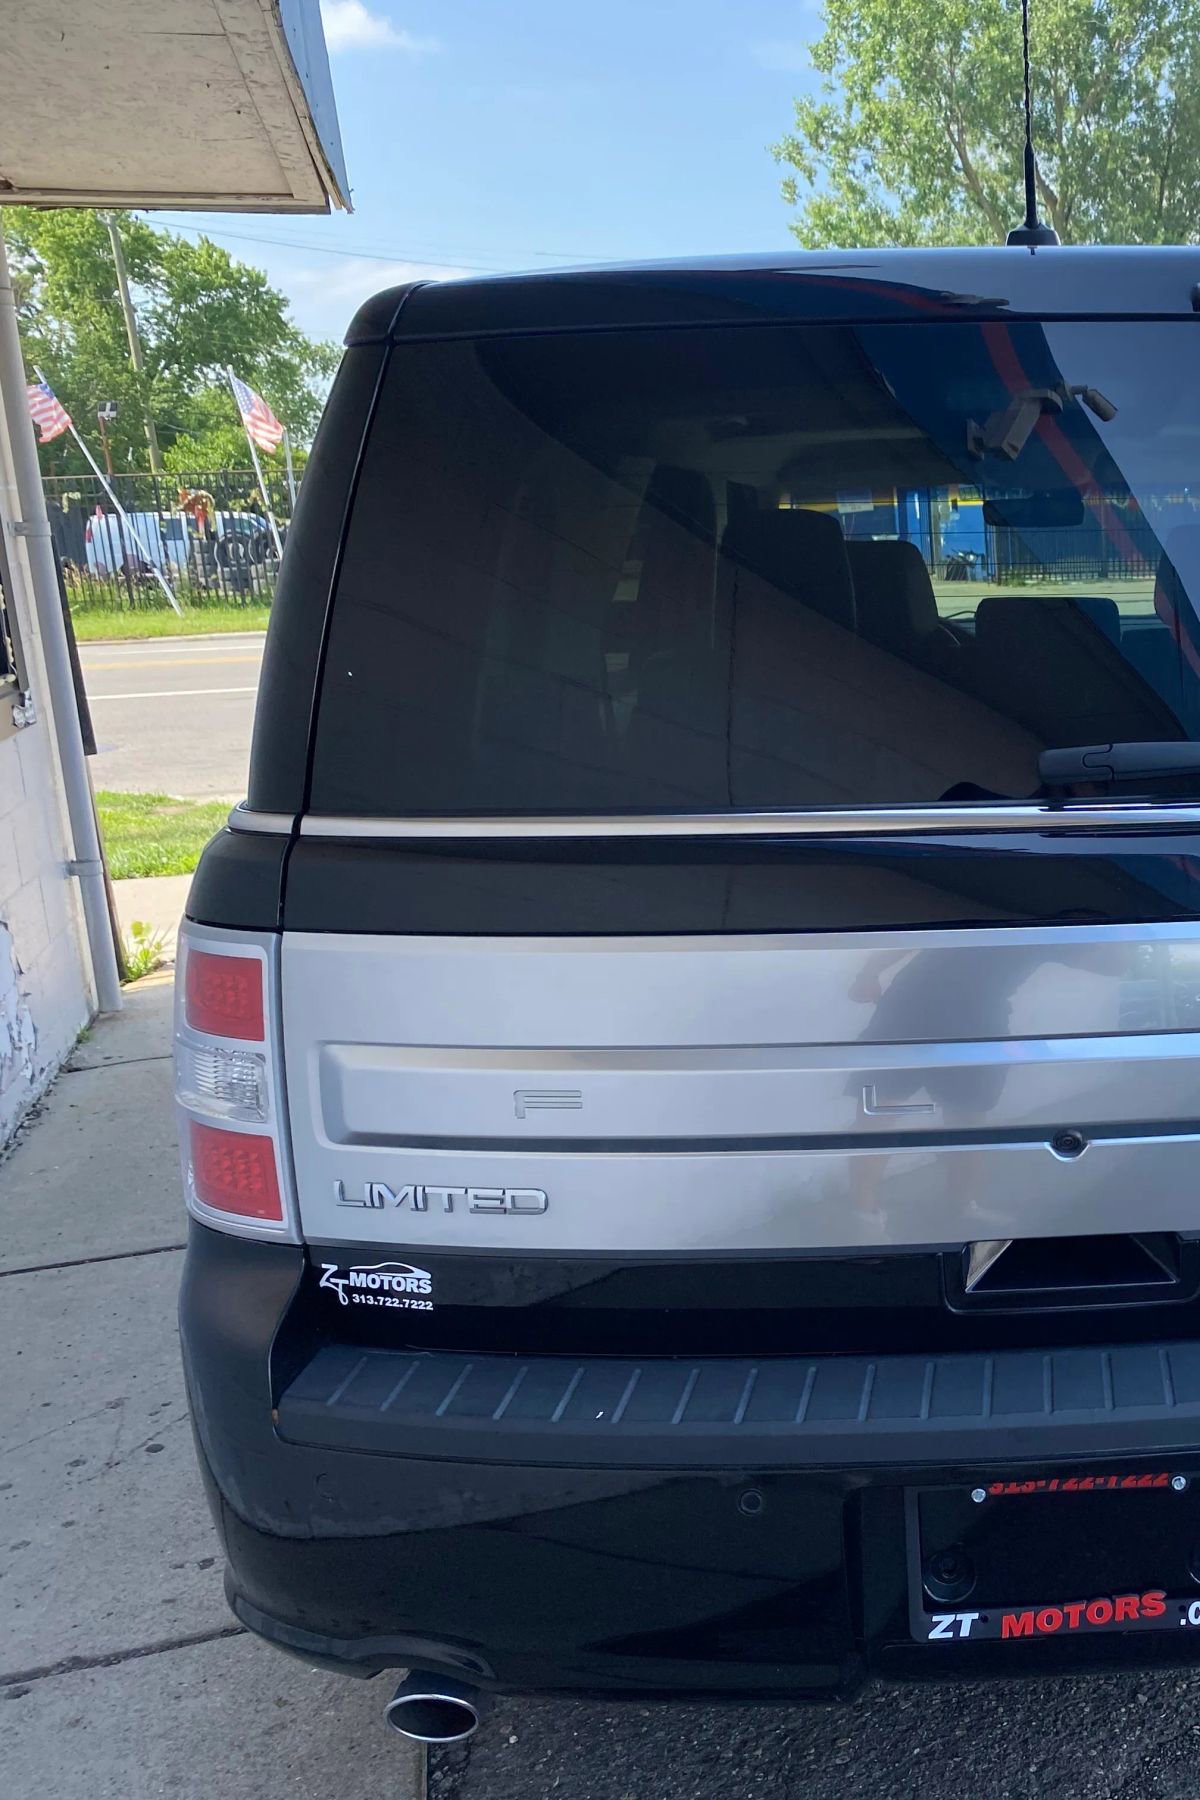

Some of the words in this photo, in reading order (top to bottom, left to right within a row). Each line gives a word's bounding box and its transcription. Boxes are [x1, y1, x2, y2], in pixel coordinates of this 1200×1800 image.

[333, 1179, 549, 1215] LIMITED
[349, 1271, 432, 1294] MOTORS
[352, 1293, 434, 1311] 313.722.7222
[927, 1612, 980, 1640] ZT
[1000, 1590, 1168, 1639] MOTORS
